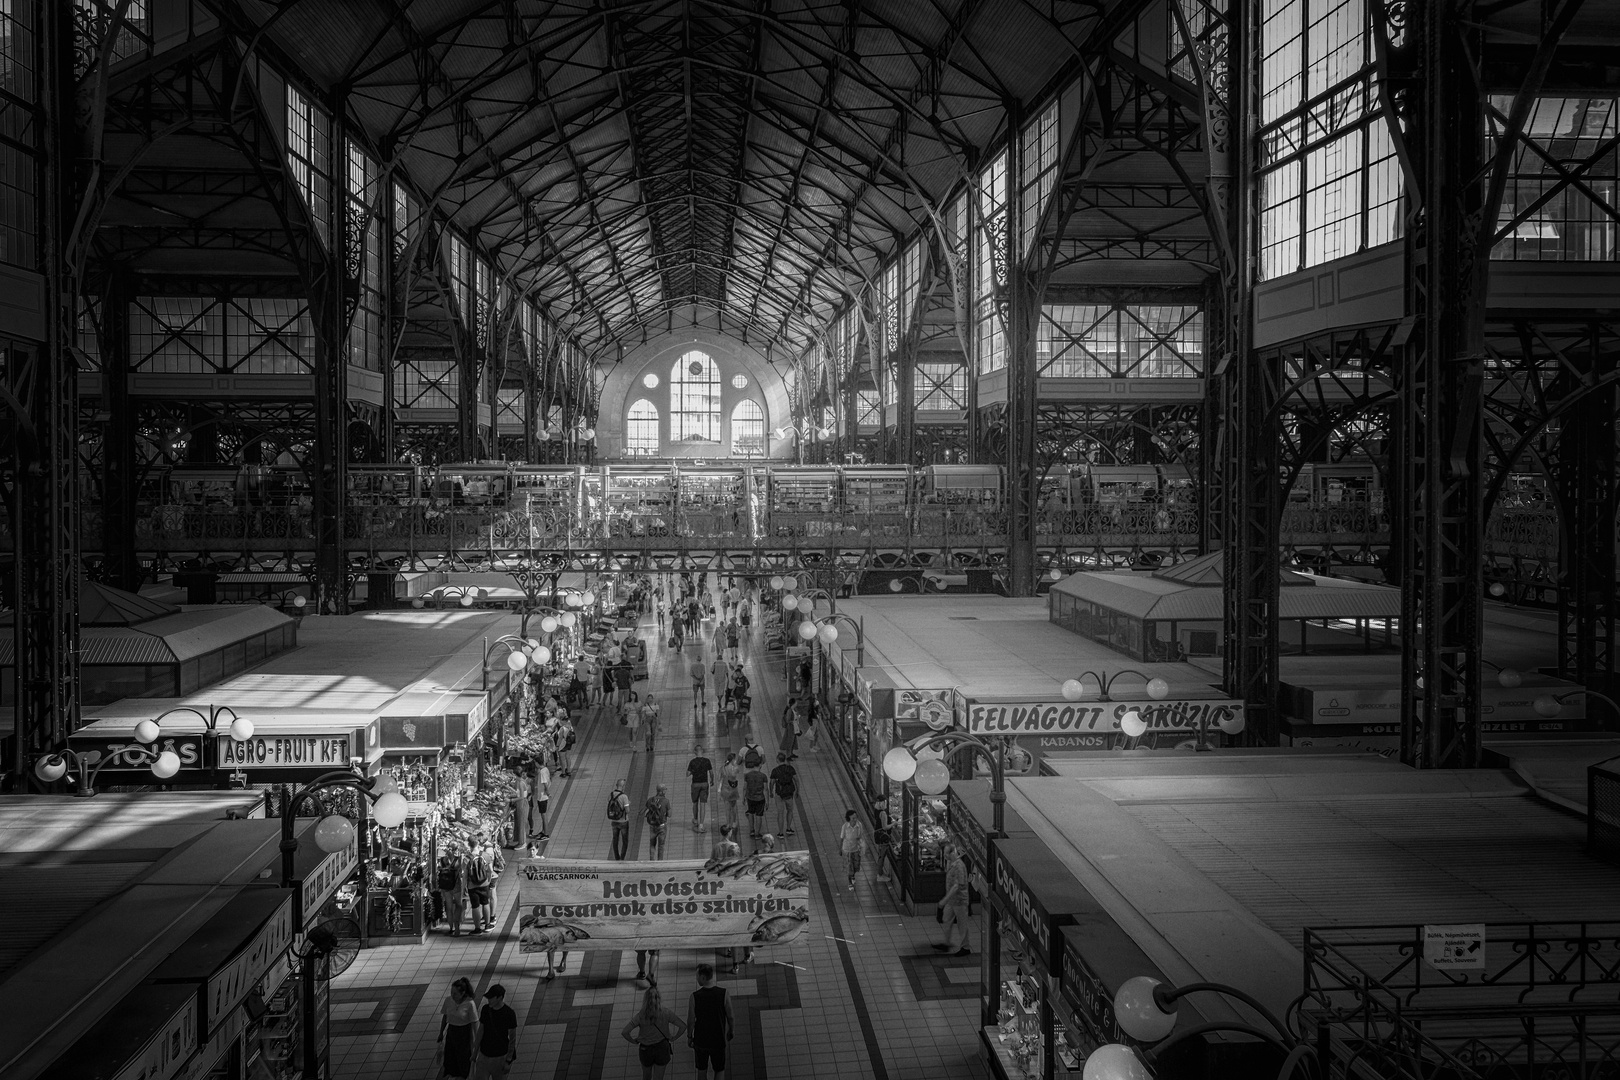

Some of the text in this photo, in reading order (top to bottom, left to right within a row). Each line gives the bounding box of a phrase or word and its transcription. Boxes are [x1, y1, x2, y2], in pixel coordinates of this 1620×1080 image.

[971, 703, 1104, 731] FELVÁGOTT
[224, 739, 316, 764] AGRO-FRUIT
[1040, 736, 1104, 747] KABANOS
[602, 876, 724, 900] Halvásár
[532, 894, 796, 919] a csarnok alsó szintjén.
[1062, 952, 1100, 1016] Chocolate
